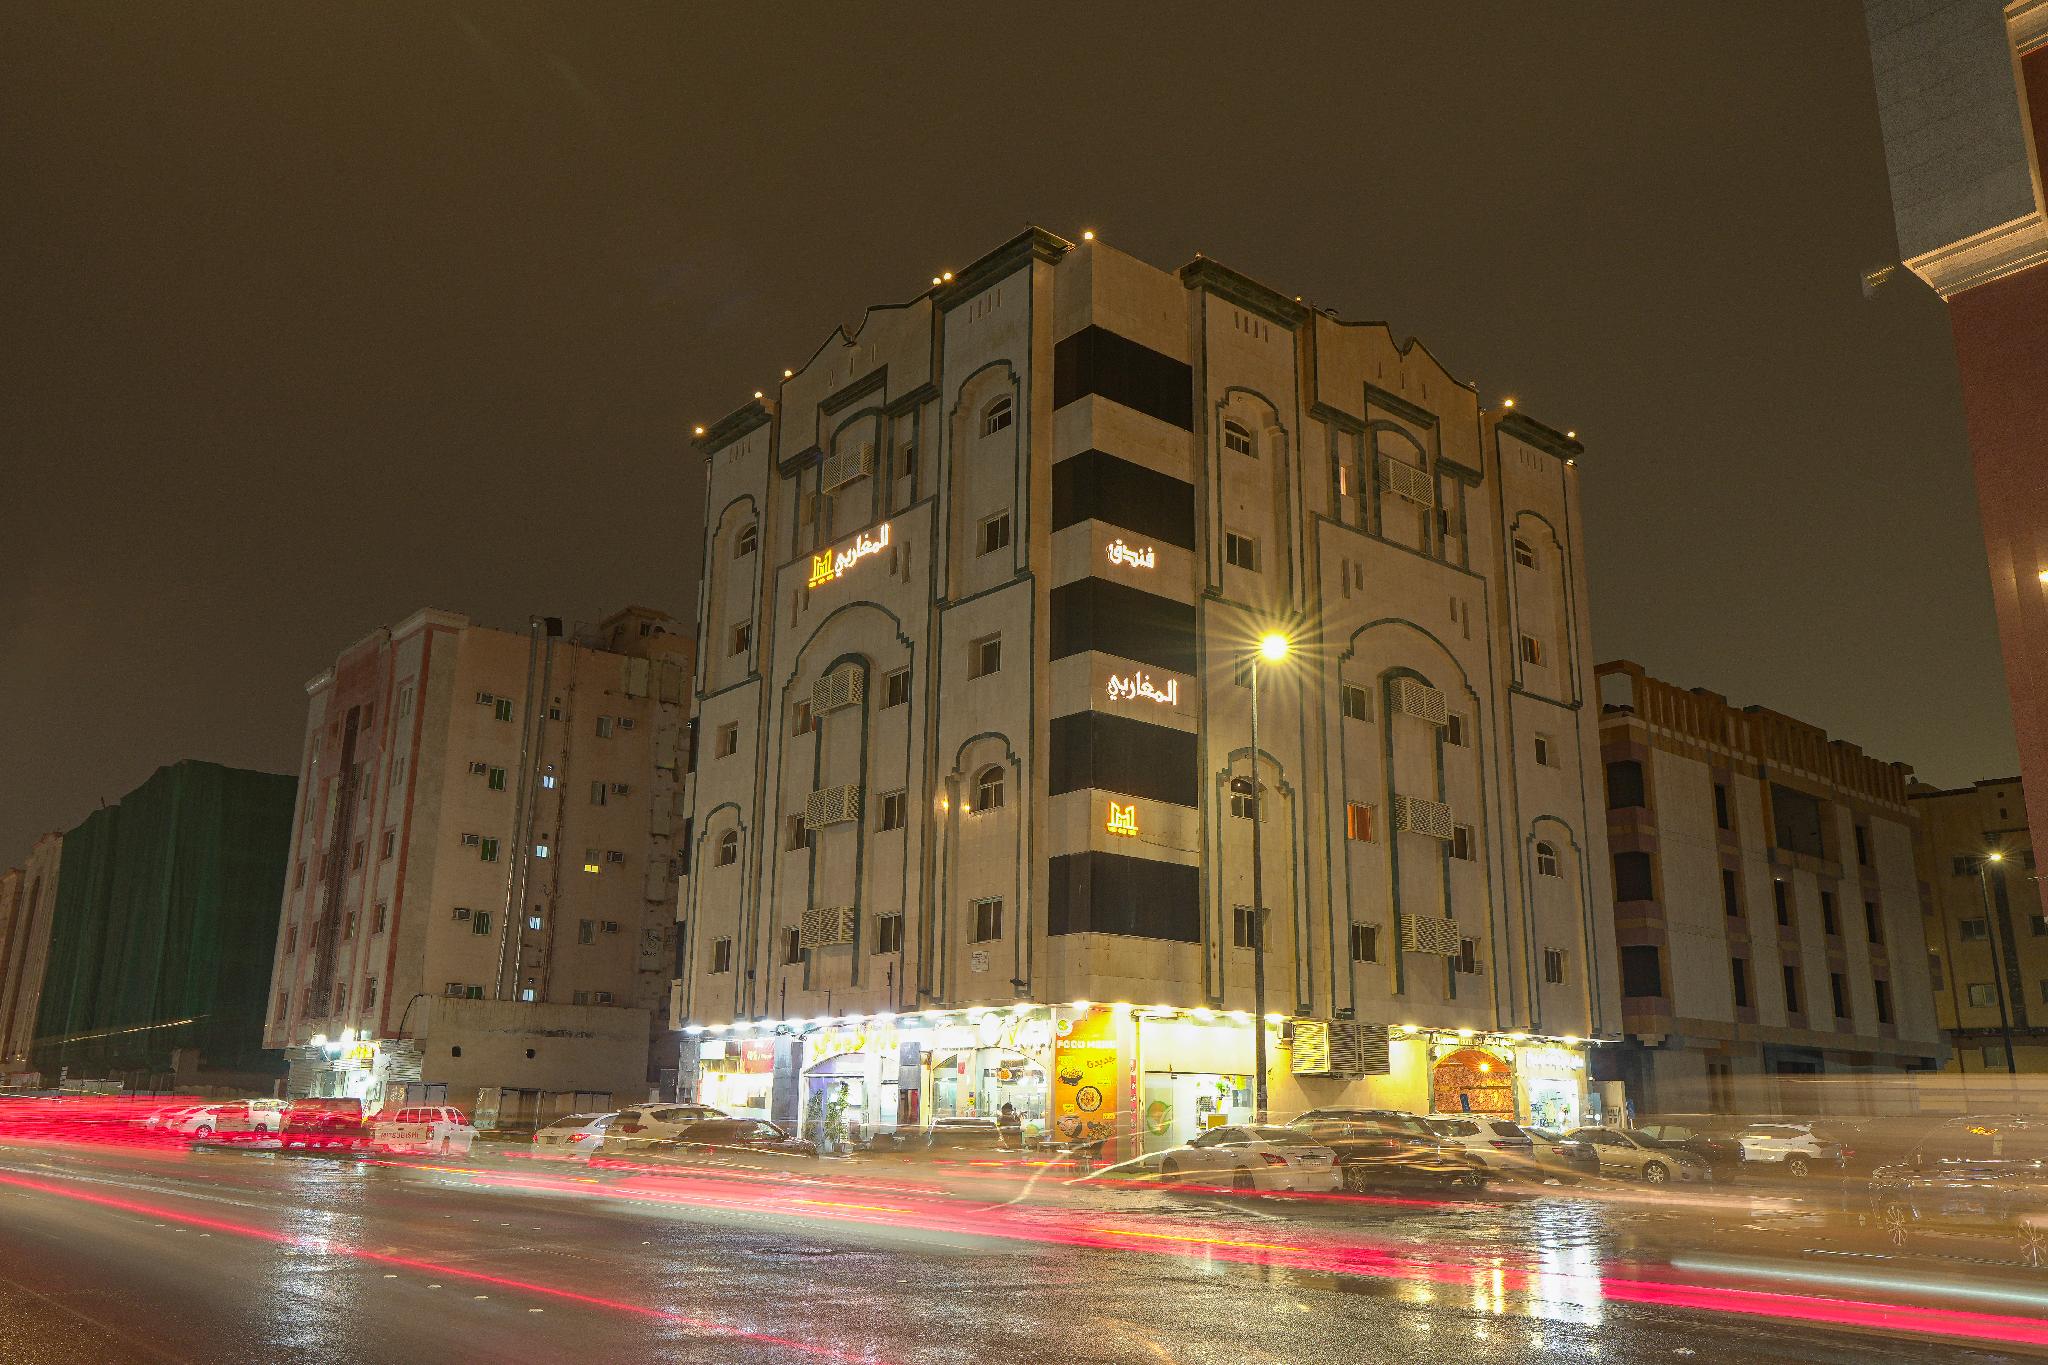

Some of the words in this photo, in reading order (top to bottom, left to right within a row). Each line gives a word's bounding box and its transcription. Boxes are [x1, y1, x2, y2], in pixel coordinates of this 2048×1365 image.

[834, 522, 891, 578] المغاربي
[1106, 538, 1156, 569] فندق
[1106, 670, 1178, 706] المغاربي
[1056, 1040, 1086, 1049] FOOD
[379, 1131, 419, 1140] MITSUBISHI
